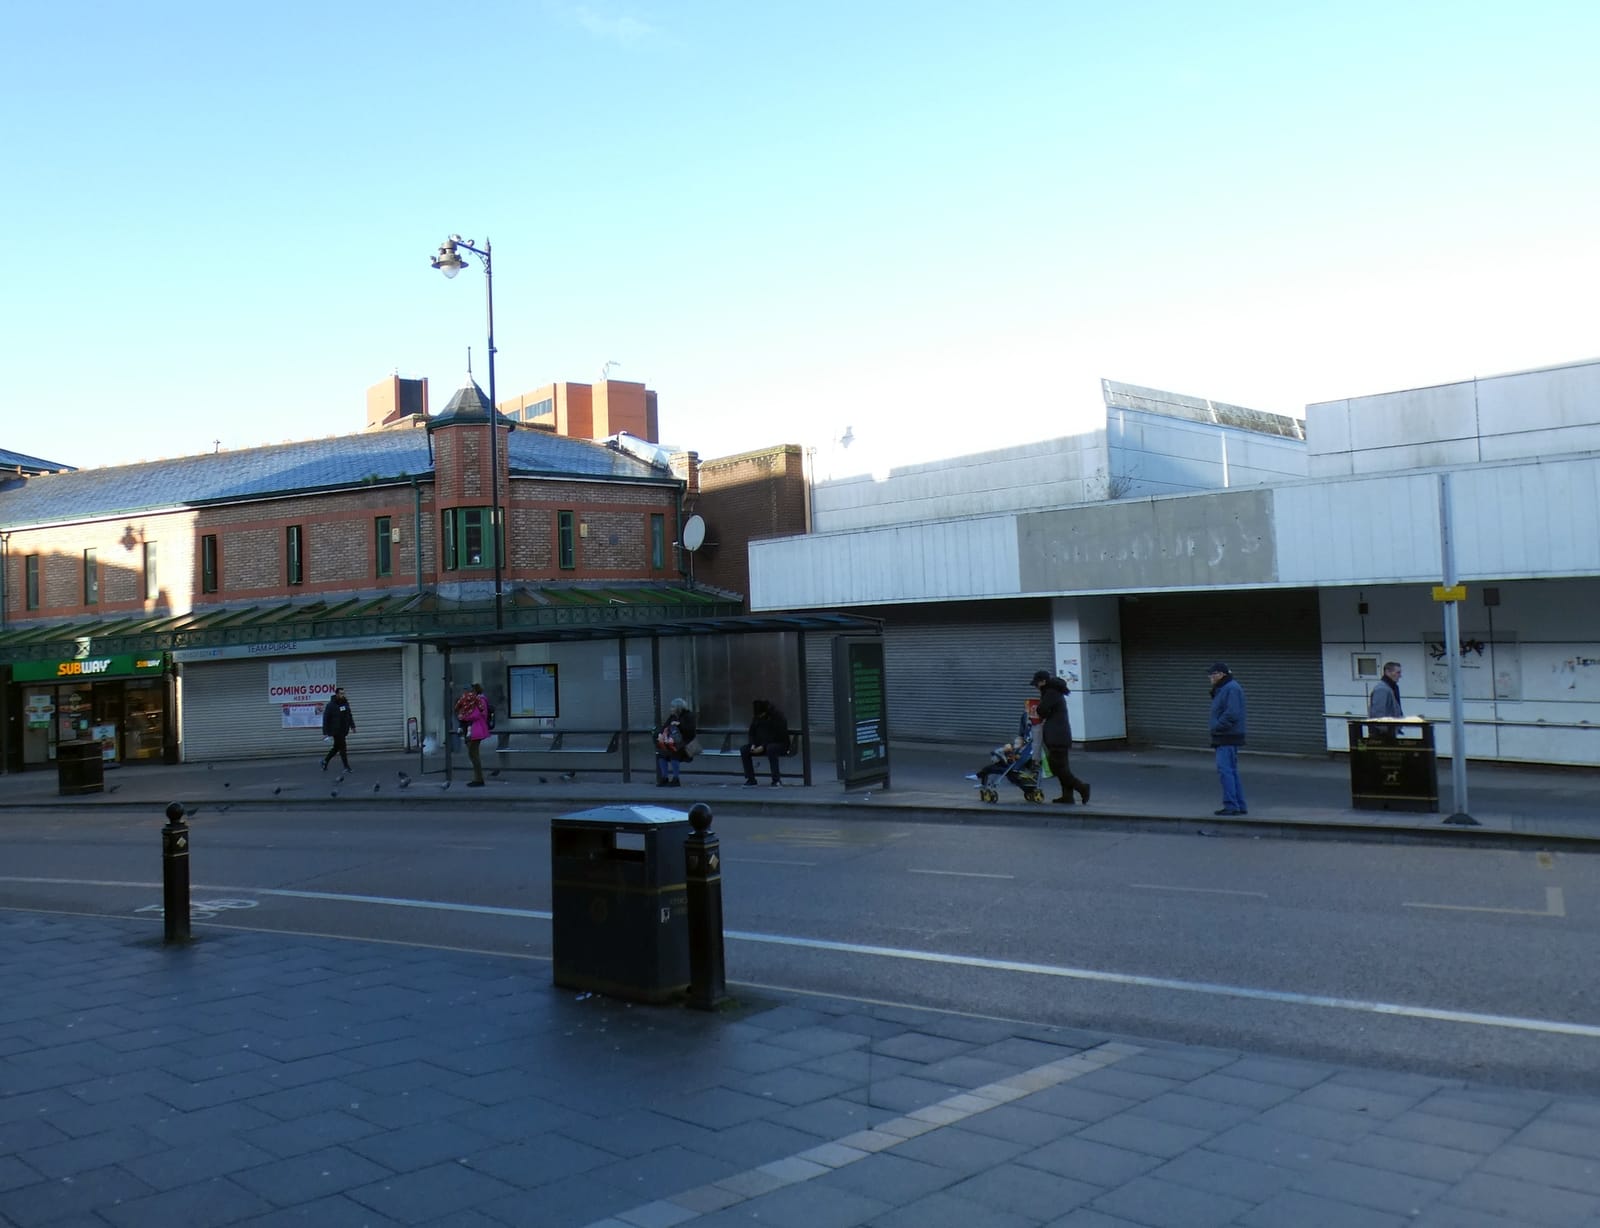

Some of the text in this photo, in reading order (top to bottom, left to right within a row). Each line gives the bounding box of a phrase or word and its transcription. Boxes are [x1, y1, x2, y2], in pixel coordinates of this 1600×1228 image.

[57, 659, 111, 675] SUBWAY
[270, 684, 336, 696] COMING SOON
